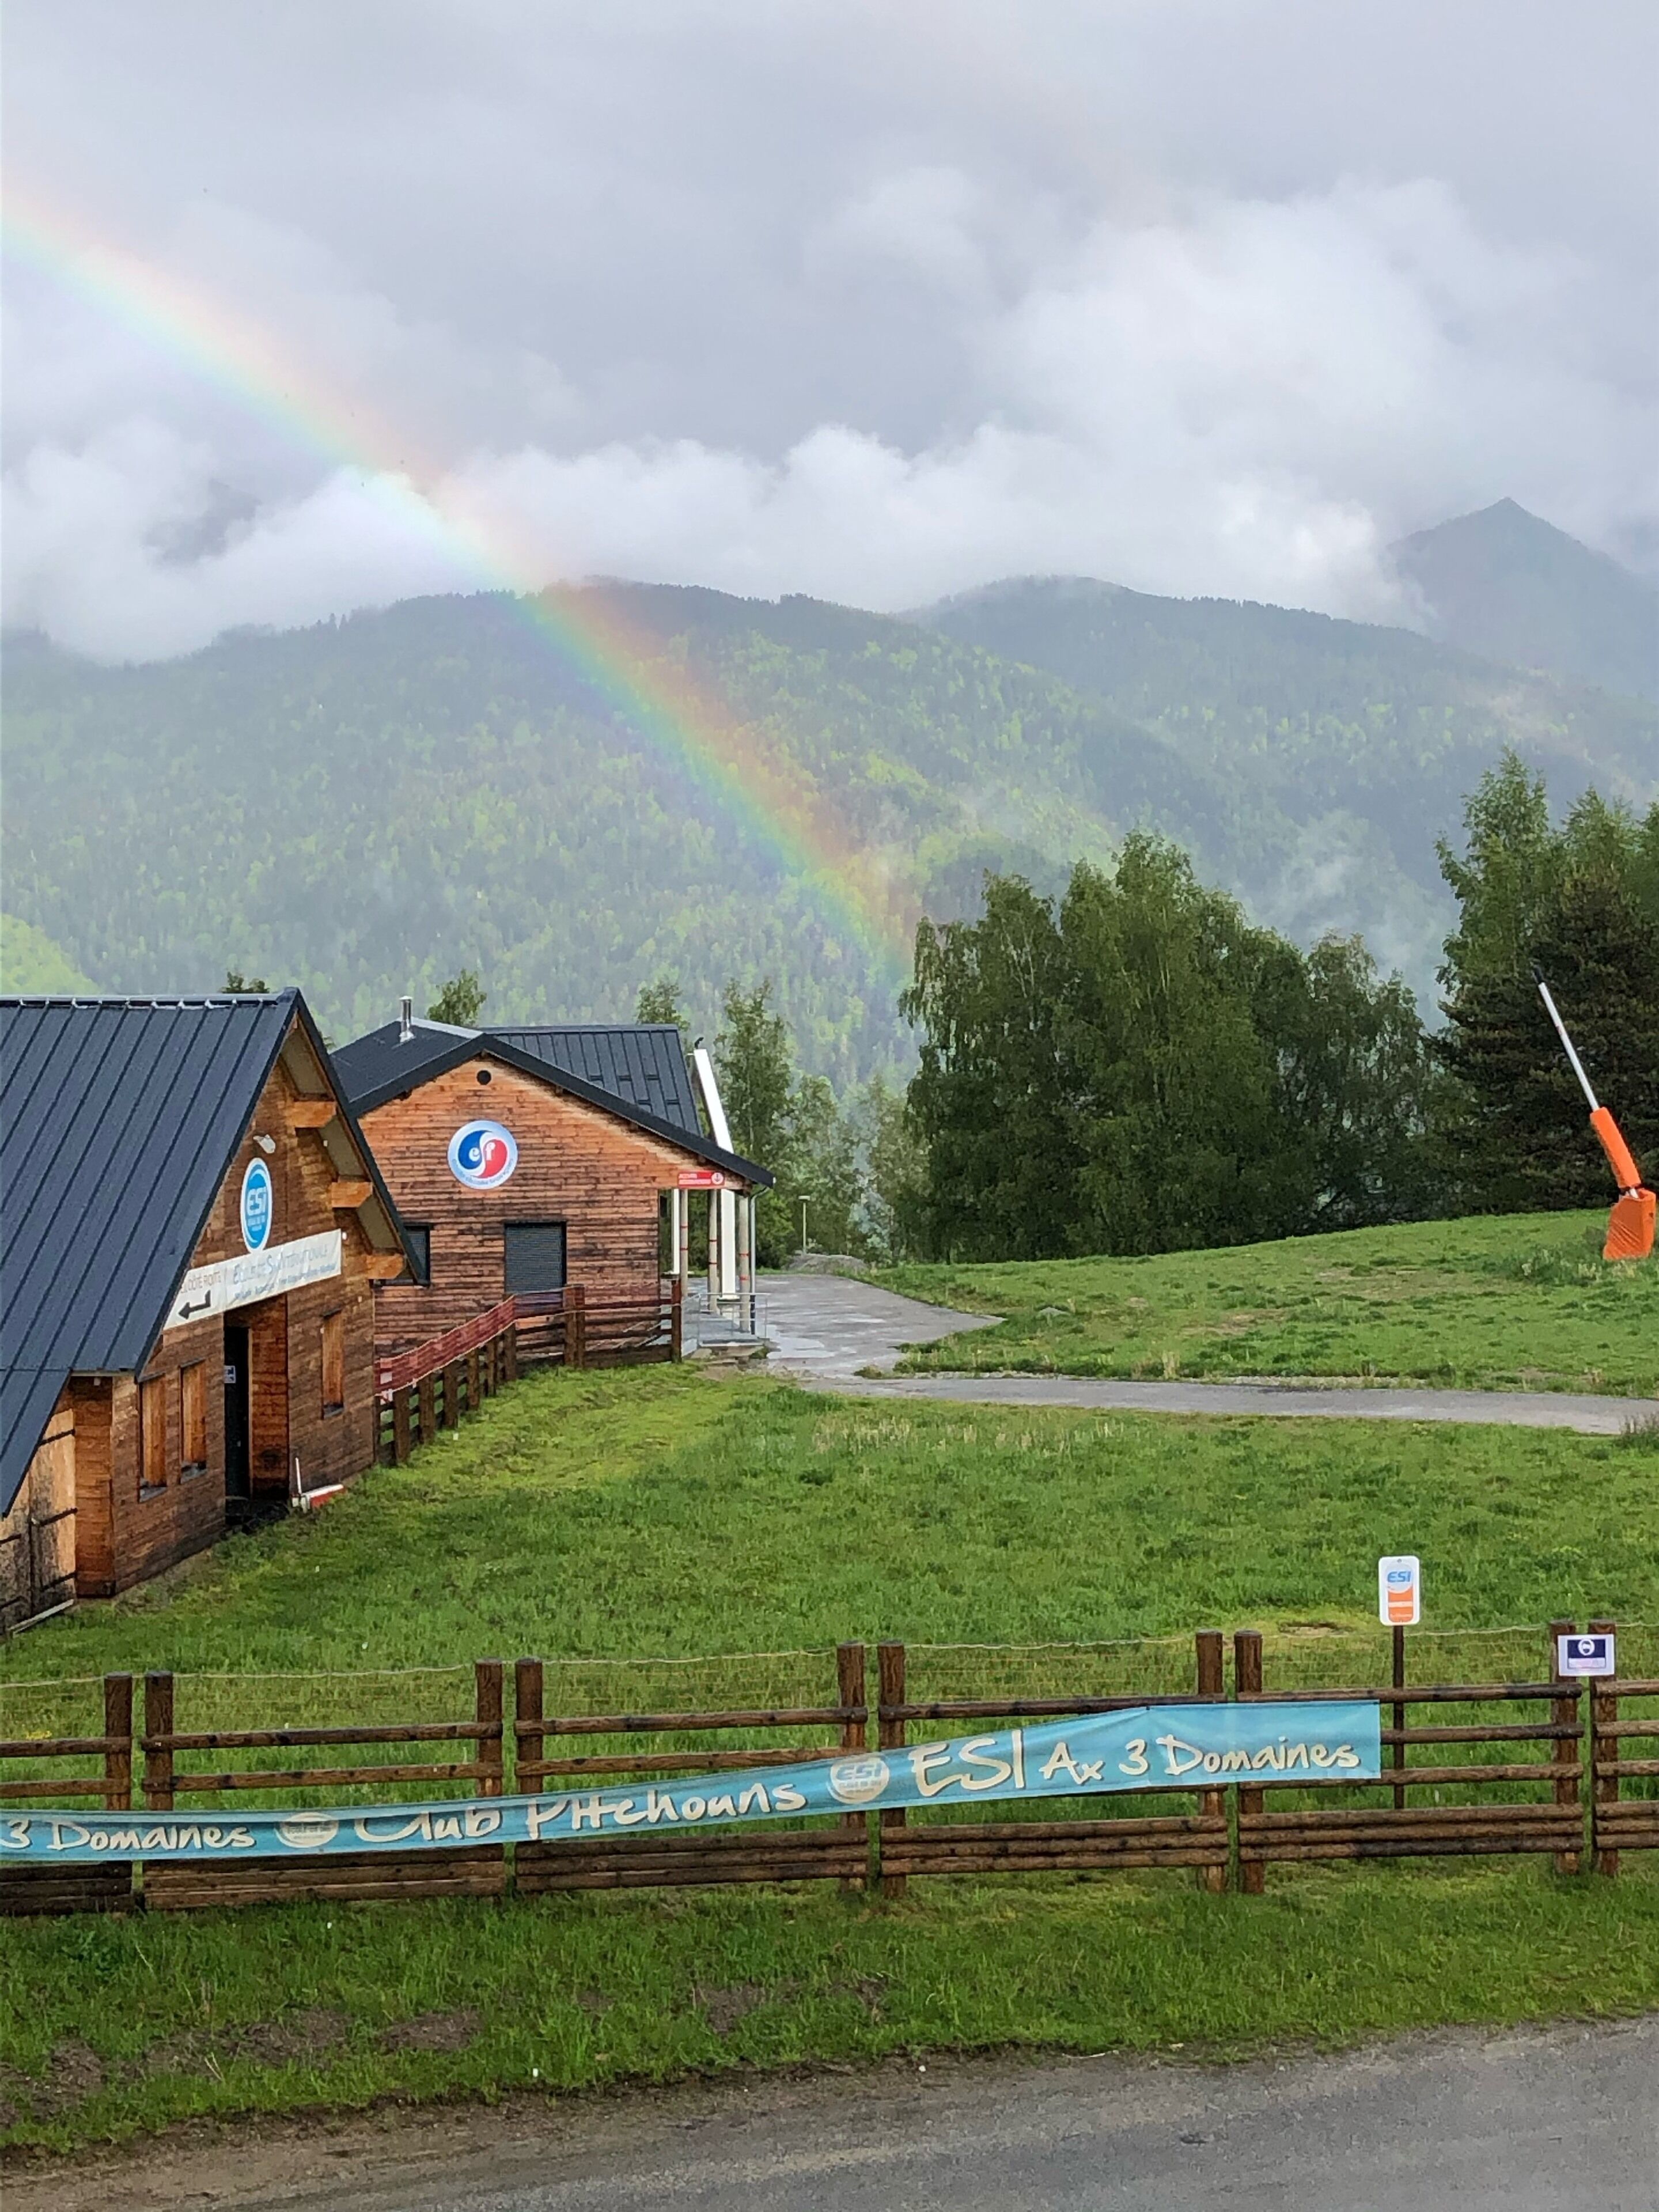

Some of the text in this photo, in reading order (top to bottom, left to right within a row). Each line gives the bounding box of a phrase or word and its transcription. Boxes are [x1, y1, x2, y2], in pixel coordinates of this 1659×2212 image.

[1388, 1571, 1411, 1582] ESI
[908, 1729, 1361, 1797] ESI Ax 3 Domaines
[0, 1819, 32, 1849] 3
[47, 1820, 255, 1851] Domaines
